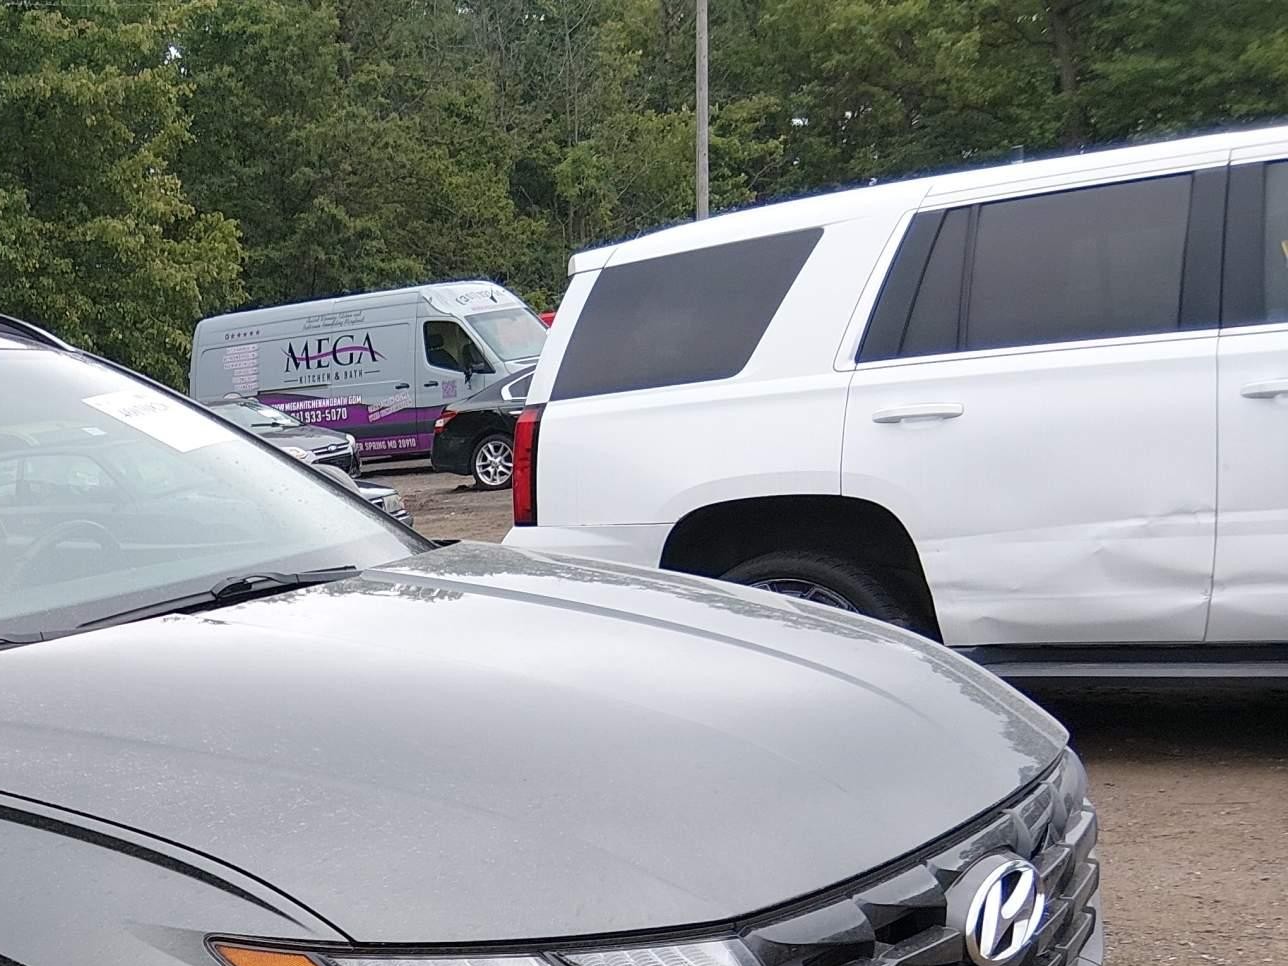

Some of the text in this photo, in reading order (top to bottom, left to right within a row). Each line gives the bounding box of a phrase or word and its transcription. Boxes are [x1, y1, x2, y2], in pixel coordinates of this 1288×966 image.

[285, 331, 379, 373] MEGA
[299, 368, 363, 384] KITCHEN & BATH
